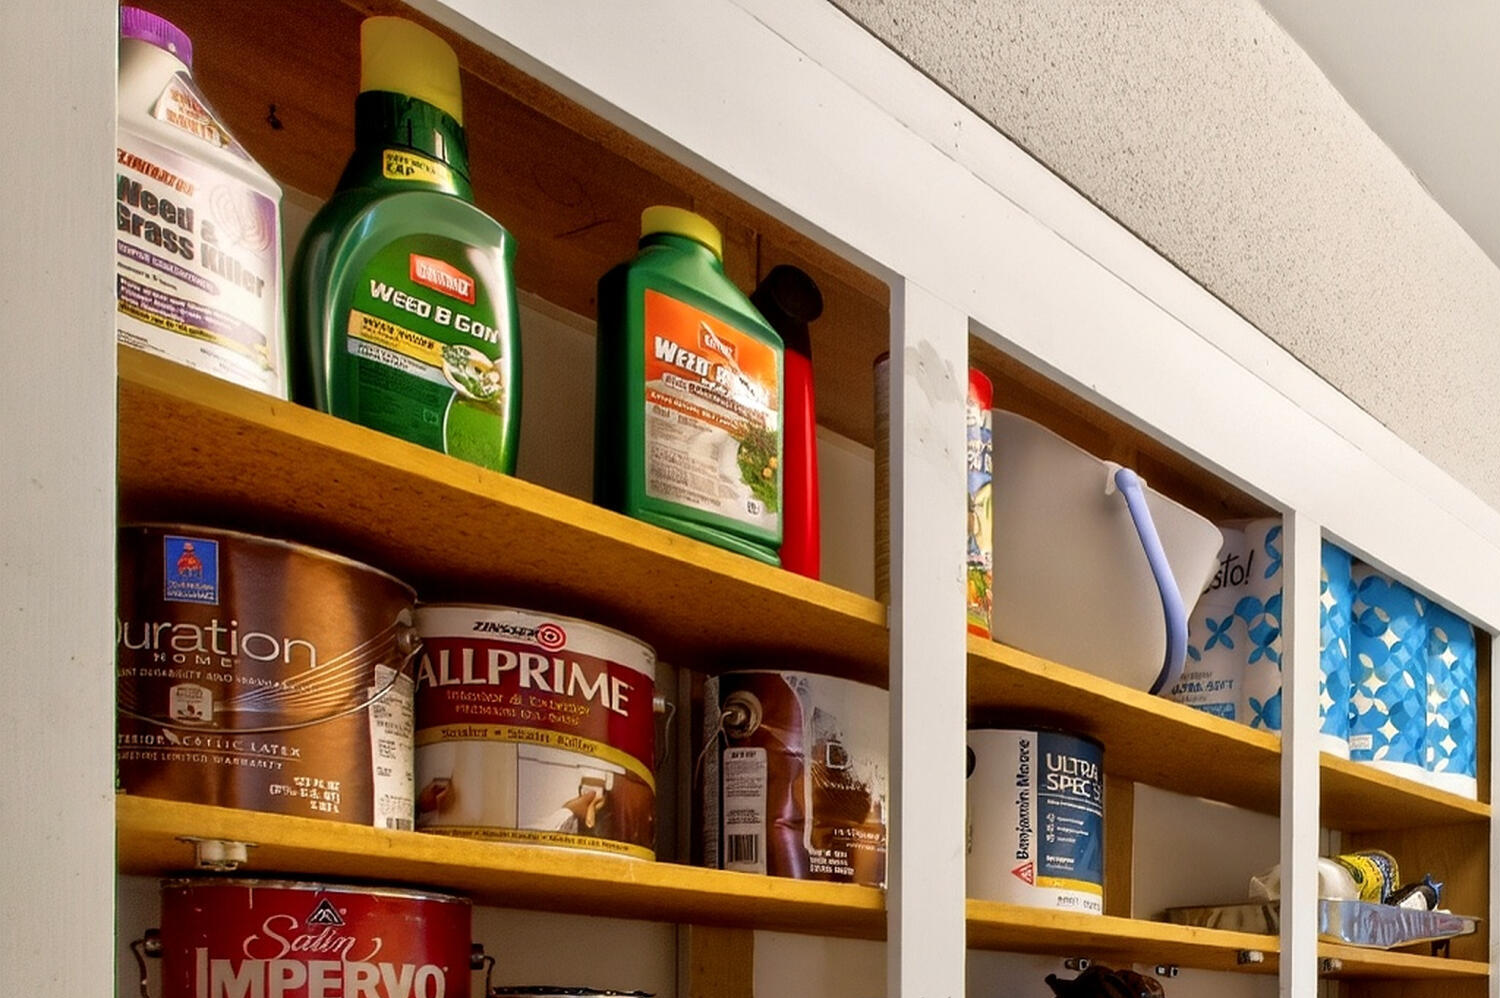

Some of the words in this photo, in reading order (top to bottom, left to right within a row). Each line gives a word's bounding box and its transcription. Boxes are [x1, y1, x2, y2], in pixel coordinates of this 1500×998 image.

[117, 201, 194, 261] Grass
[201, 242, 265, 298] Killer
[370, 279, 431, 318] WEED
[434, 306, 452, 326] B
[655, 335, 710, 377] WEED
[1203, 549, 1254, 594] sto!
[117, 617, 316, 669] uration
[415, 648, 629, 717] ALLPRIME
[118, 733, 165, 745] TERIOR
[243, 914, 382, 962] Satin
